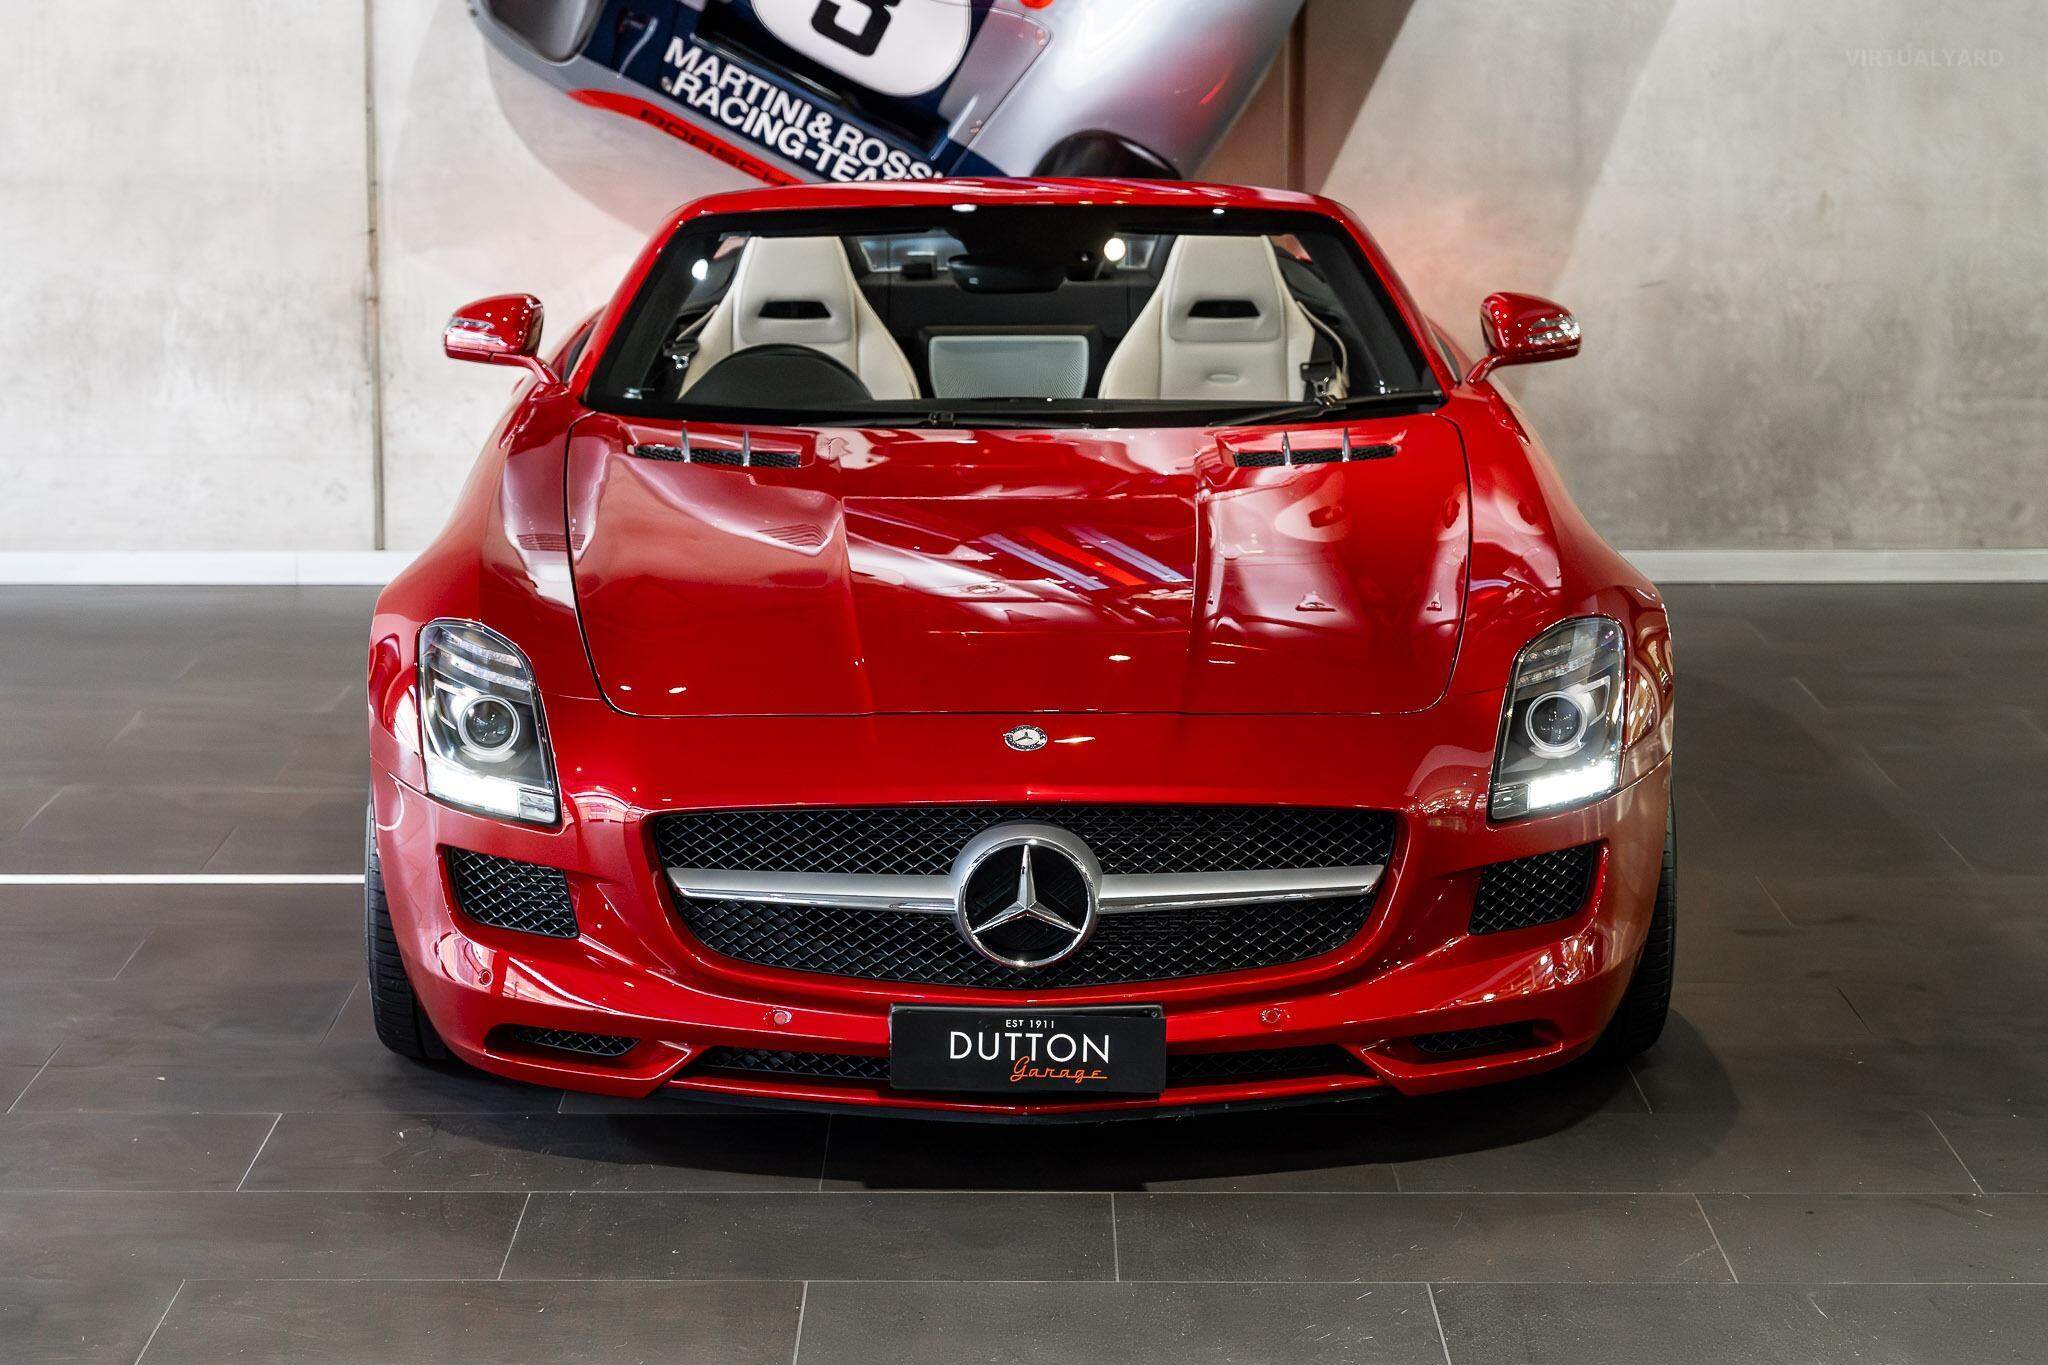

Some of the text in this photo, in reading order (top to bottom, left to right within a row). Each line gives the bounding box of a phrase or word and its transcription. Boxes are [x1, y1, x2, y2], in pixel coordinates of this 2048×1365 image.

[663, 36, 944, 180] MARTINI&ROSS
[1006, 1019, 1055, 1029] EST 1911
[950, 1031, 1110, 1064] DUTTON
[1010, 1055, 1108, 1084] Garage
